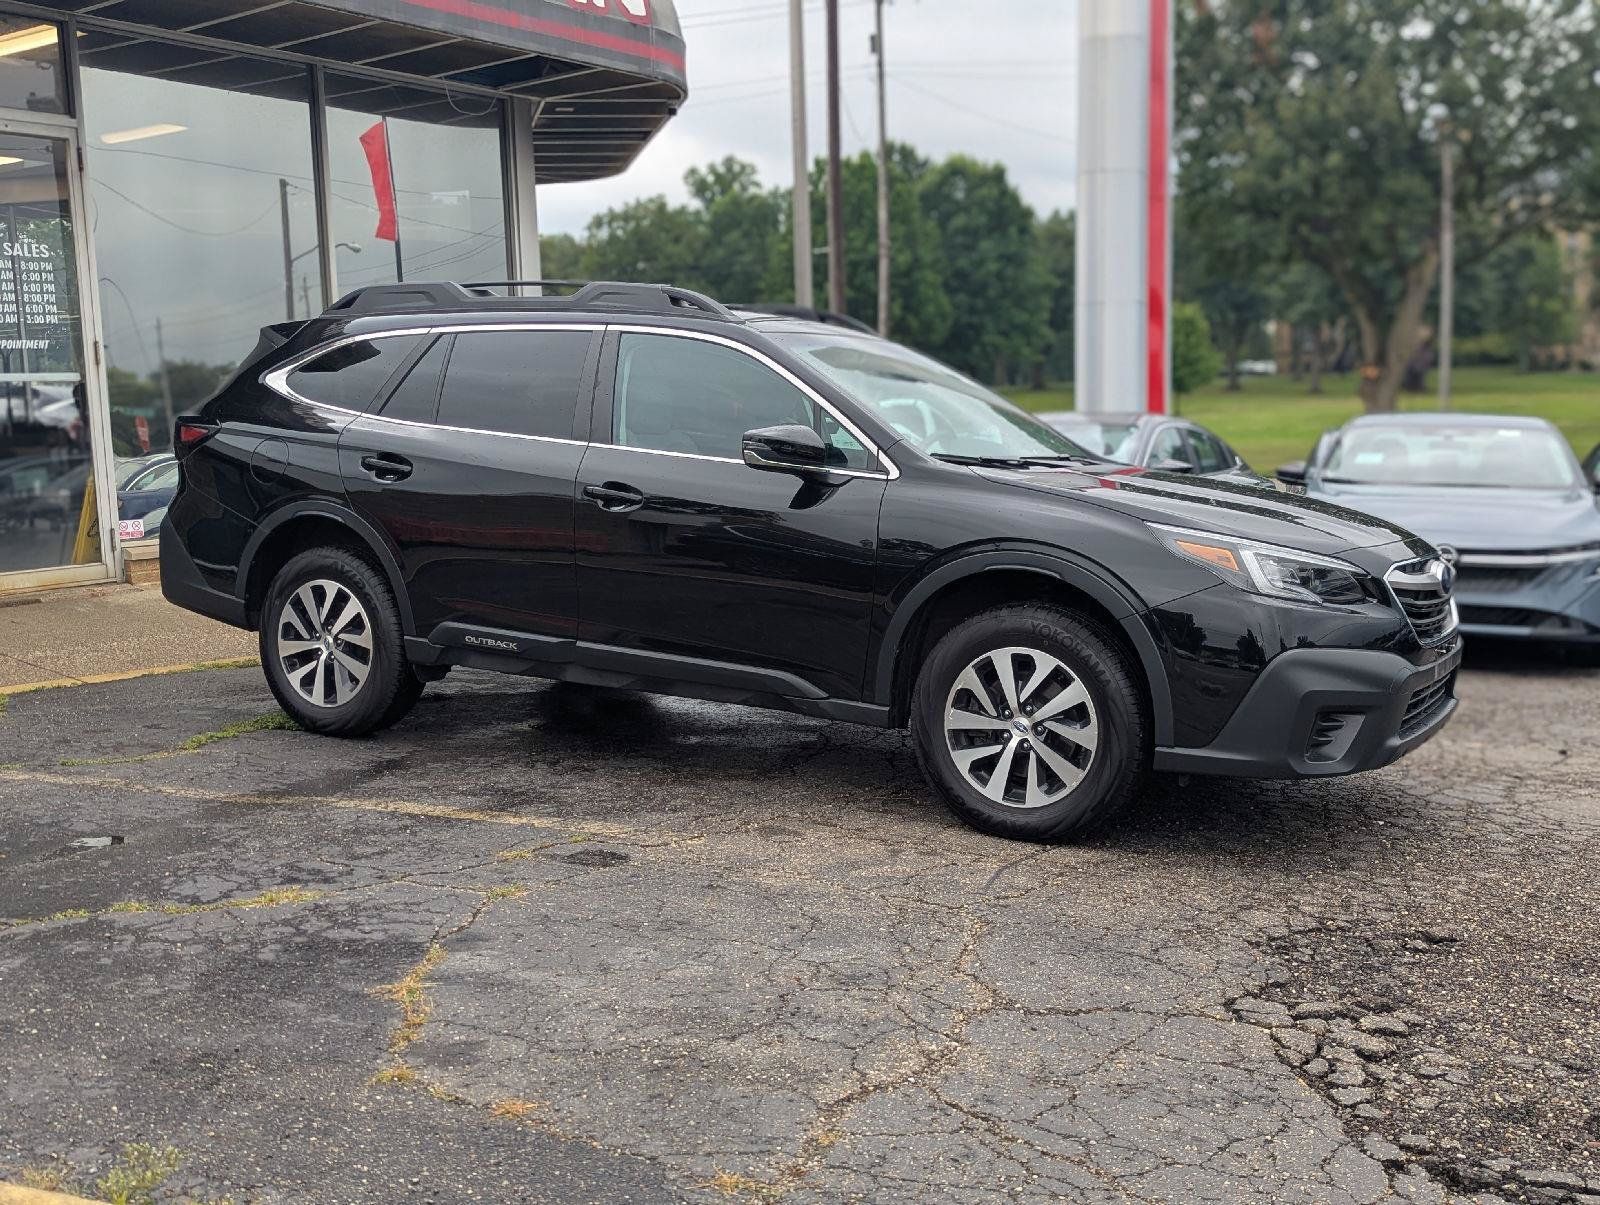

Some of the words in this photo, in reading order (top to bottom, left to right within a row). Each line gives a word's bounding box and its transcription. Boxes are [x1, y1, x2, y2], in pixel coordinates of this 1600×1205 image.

[3, 242, 49, 258] SALES
[0, 260, 12, 269] AM
[20, 261, 39, 270] 8:00
[41, 262, 53, 271] PM
[1, 271, 13, 280] AM
[22, 272, 40, 281] 6:00
[42, 272, 54, 281] PM
[2, 282, 15, 291] AM
[23, 283, 41, 292] 6:00
[43, 283, 55, 292] PM
[3, 292, 16, 301] AM
[24, 294, 42, 303] 8:00
[44, 294, 56, 303] PM
[4, 303, 17, 312] AM
[25, 304, 43, 313] 6:00
[45, 304, 57, 314] PM
[5, 314, 18, 323] AM
[27, 315, 44, 324] 3:00
[46, 315, 58, 324] PM
[0, 339, 50, 349] POINTMENT
[465, 635, 518, 650] OUTBACK
